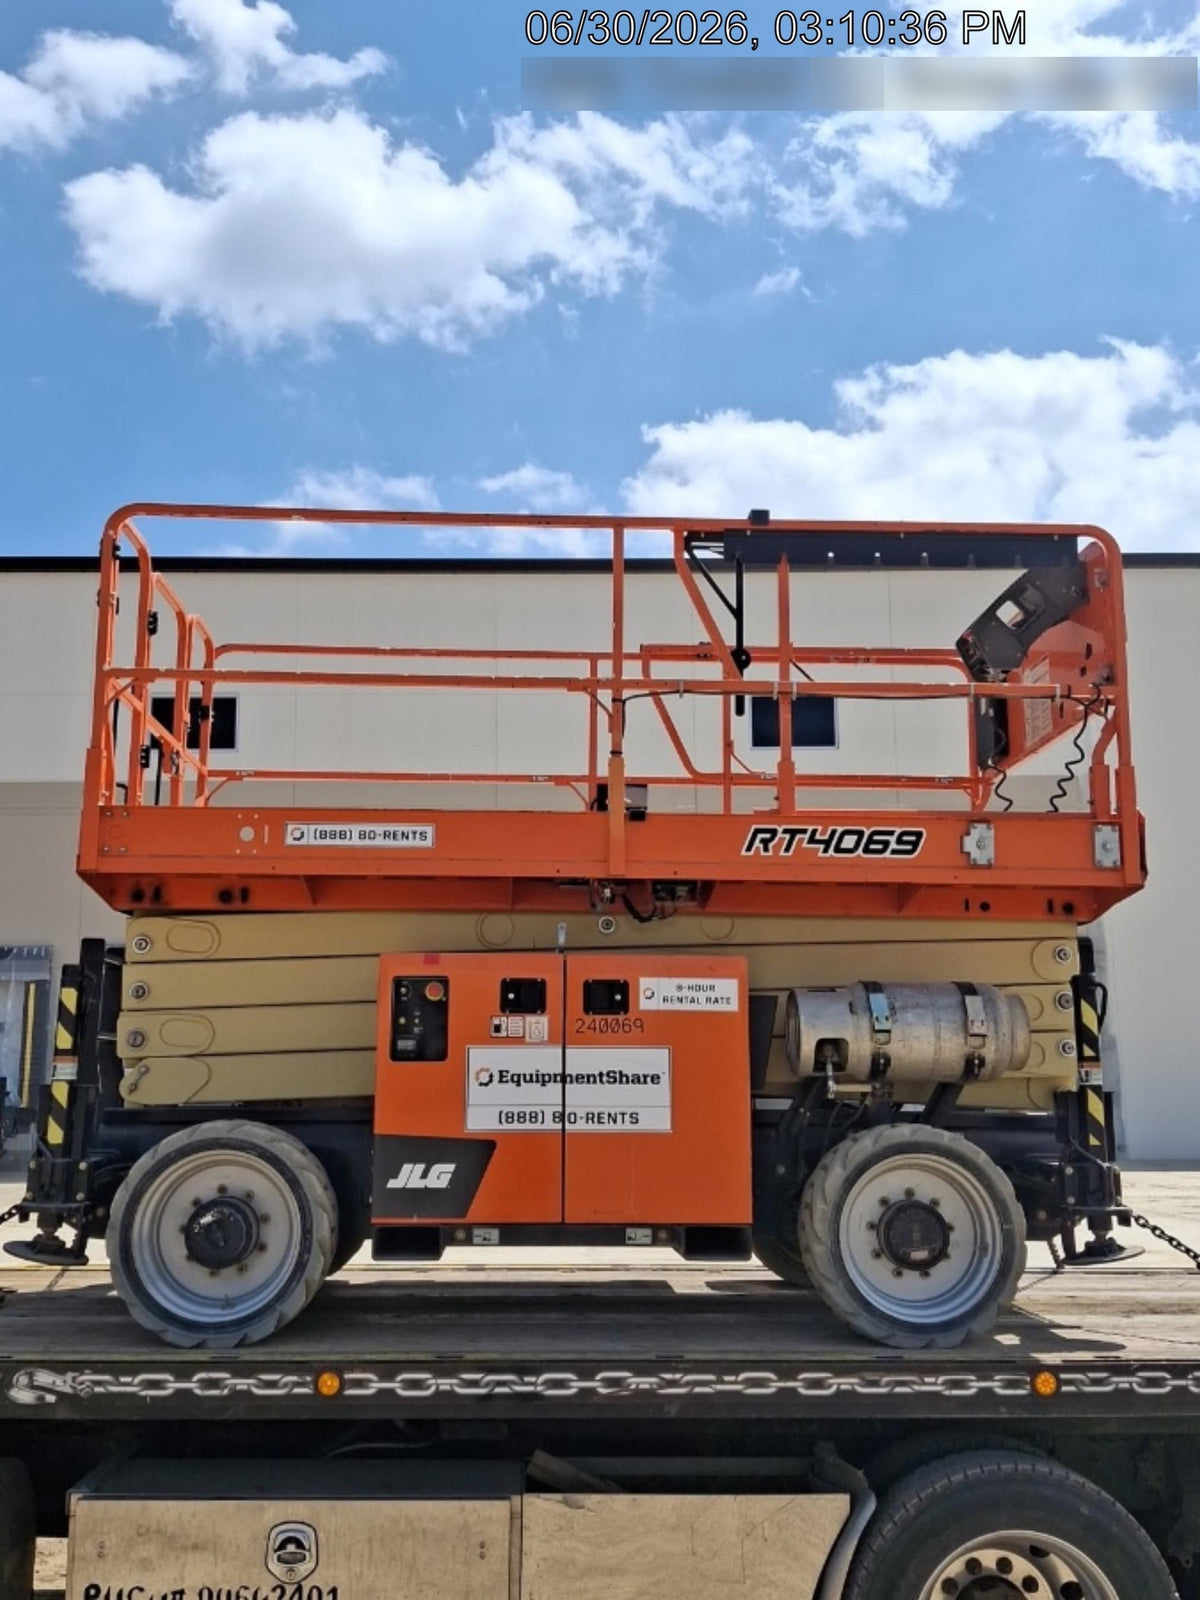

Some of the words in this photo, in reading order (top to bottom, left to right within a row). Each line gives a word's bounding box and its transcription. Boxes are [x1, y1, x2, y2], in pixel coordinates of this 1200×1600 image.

[314, 828, 352, 841] (888)
[358, 829, 427, 841] 80-RENTS
[743, 827, 925, 857] RT4069
[662, 996, 701, 1005] RENTAL
[705, 996, 731, 1005] RATE
[575, 1018, 645, 1034] 240069
[497, 1069, 661, 1087] EquipmentShare
[499, 1110, 545, 1125] (888)
[552, 1111, 639, 1125] 80-RENTS
[386, 1163, 456, 1188] JLG
